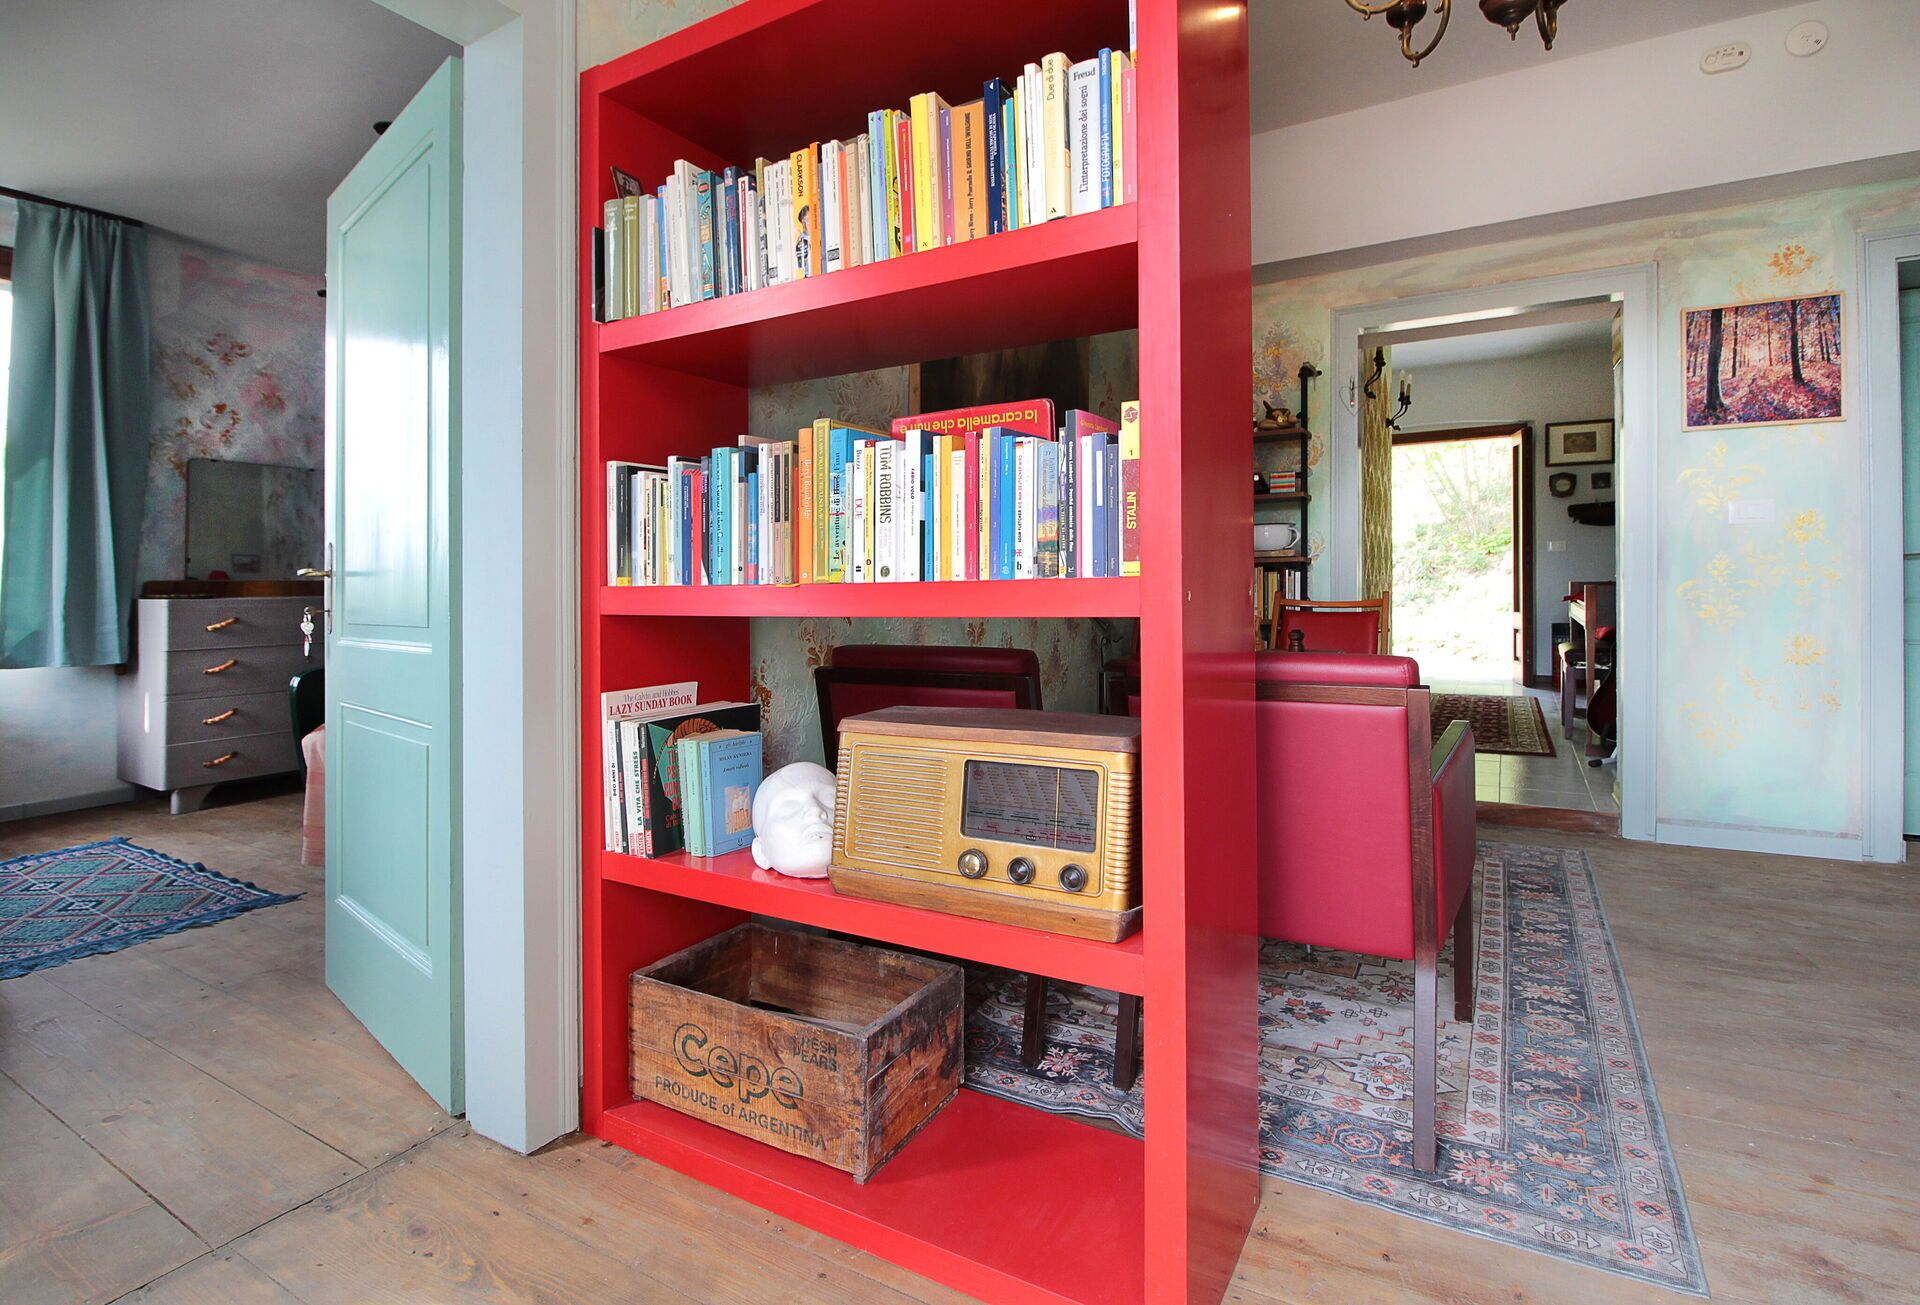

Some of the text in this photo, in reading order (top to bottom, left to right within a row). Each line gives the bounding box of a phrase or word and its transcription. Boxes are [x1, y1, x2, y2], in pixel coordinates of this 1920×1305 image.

[1046, 73, 1054, 82] di
[1073, 67, 1096, 81] Freud
[1079, 85, 1090, 193] L'interpretazione dei sogni
[1101, 133, 1110, 182] FOTOGRAFIA
[932, 419, 955, 433] che
[957, 411, 1022, 430] caramella
[1025, 409, 1037, 423] la
[879, 445, 892, 470] TOM
[855, 498, 863, 519] DUE
[879, 474, 892, 523] ROBBINS
[1126, 491, 1137, 529] STALIN
[833, 549, 840, 560] Le
[610, 695, 692, 716] LAZY SUNDAY BOOK
[624, 695, 634, 703] The
[635, 692, 650, 701] Calvin
[662, 689, 679, 698] Hobbes
[733, 752, 752, 760] KUNDERA
[637, 817, 642, 826] LA
[673, 1023, 804, 1109] Cepe
[655, 1076, 827, 1151] PRODUCE of ARGENTINA
